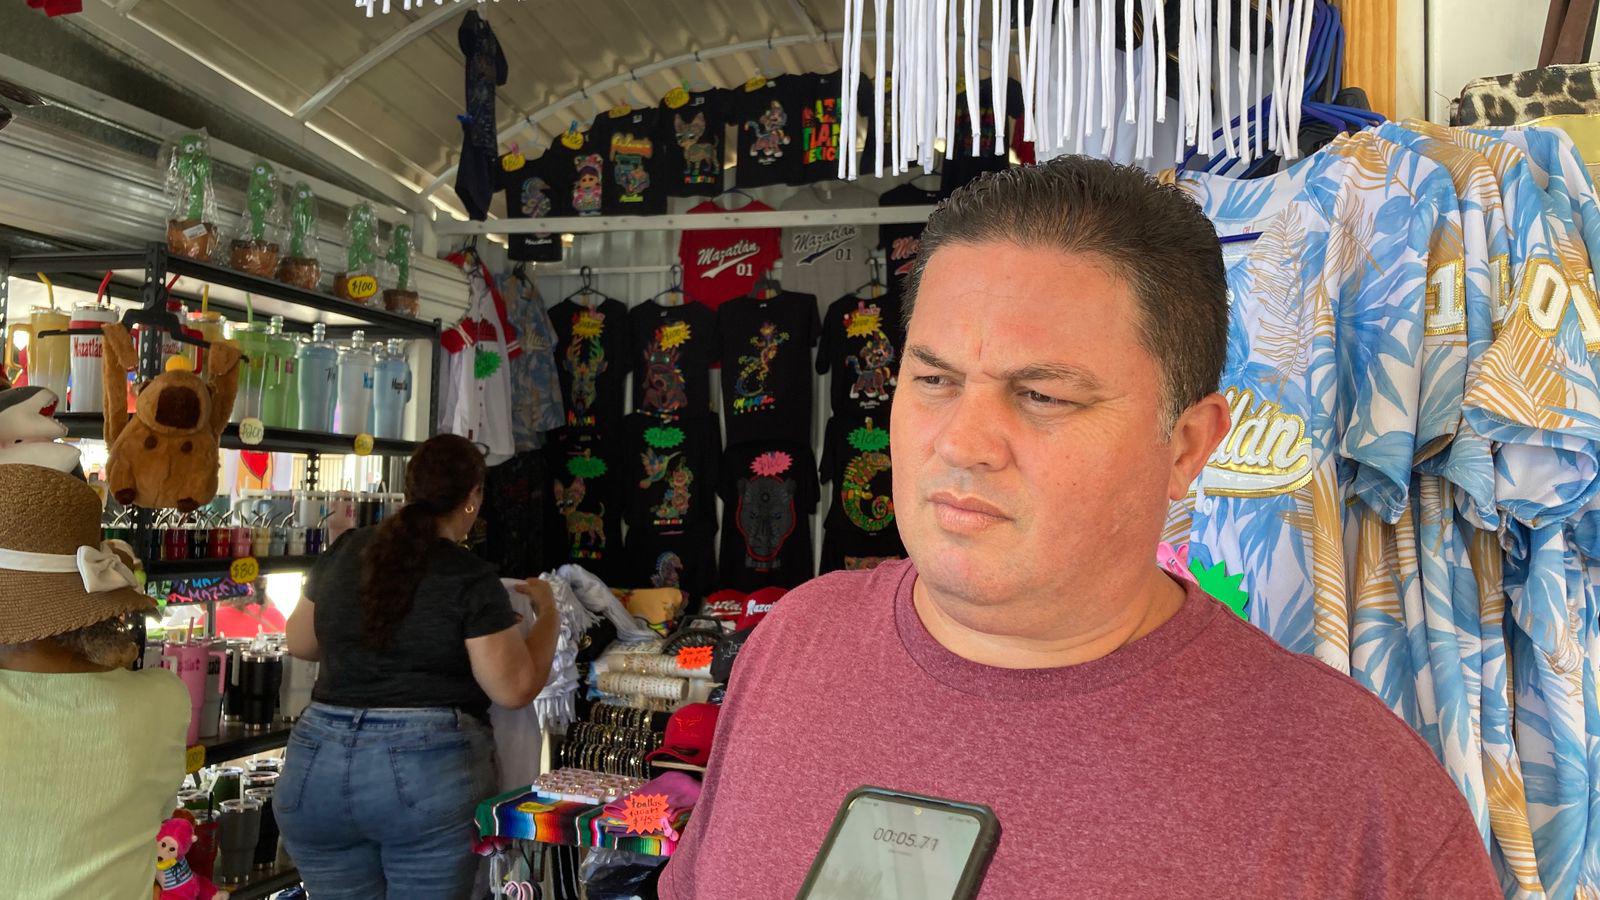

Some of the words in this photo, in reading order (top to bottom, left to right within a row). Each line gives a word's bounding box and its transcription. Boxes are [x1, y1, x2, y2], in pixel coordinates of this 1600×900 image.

[835, 248, 853, 262] 01
[736, 264, 753, 277] 01
[352, 280, 373, 294] $100
[232, 563, 256, 579] $80
[872, 826, 940, 852] 00:05.71
